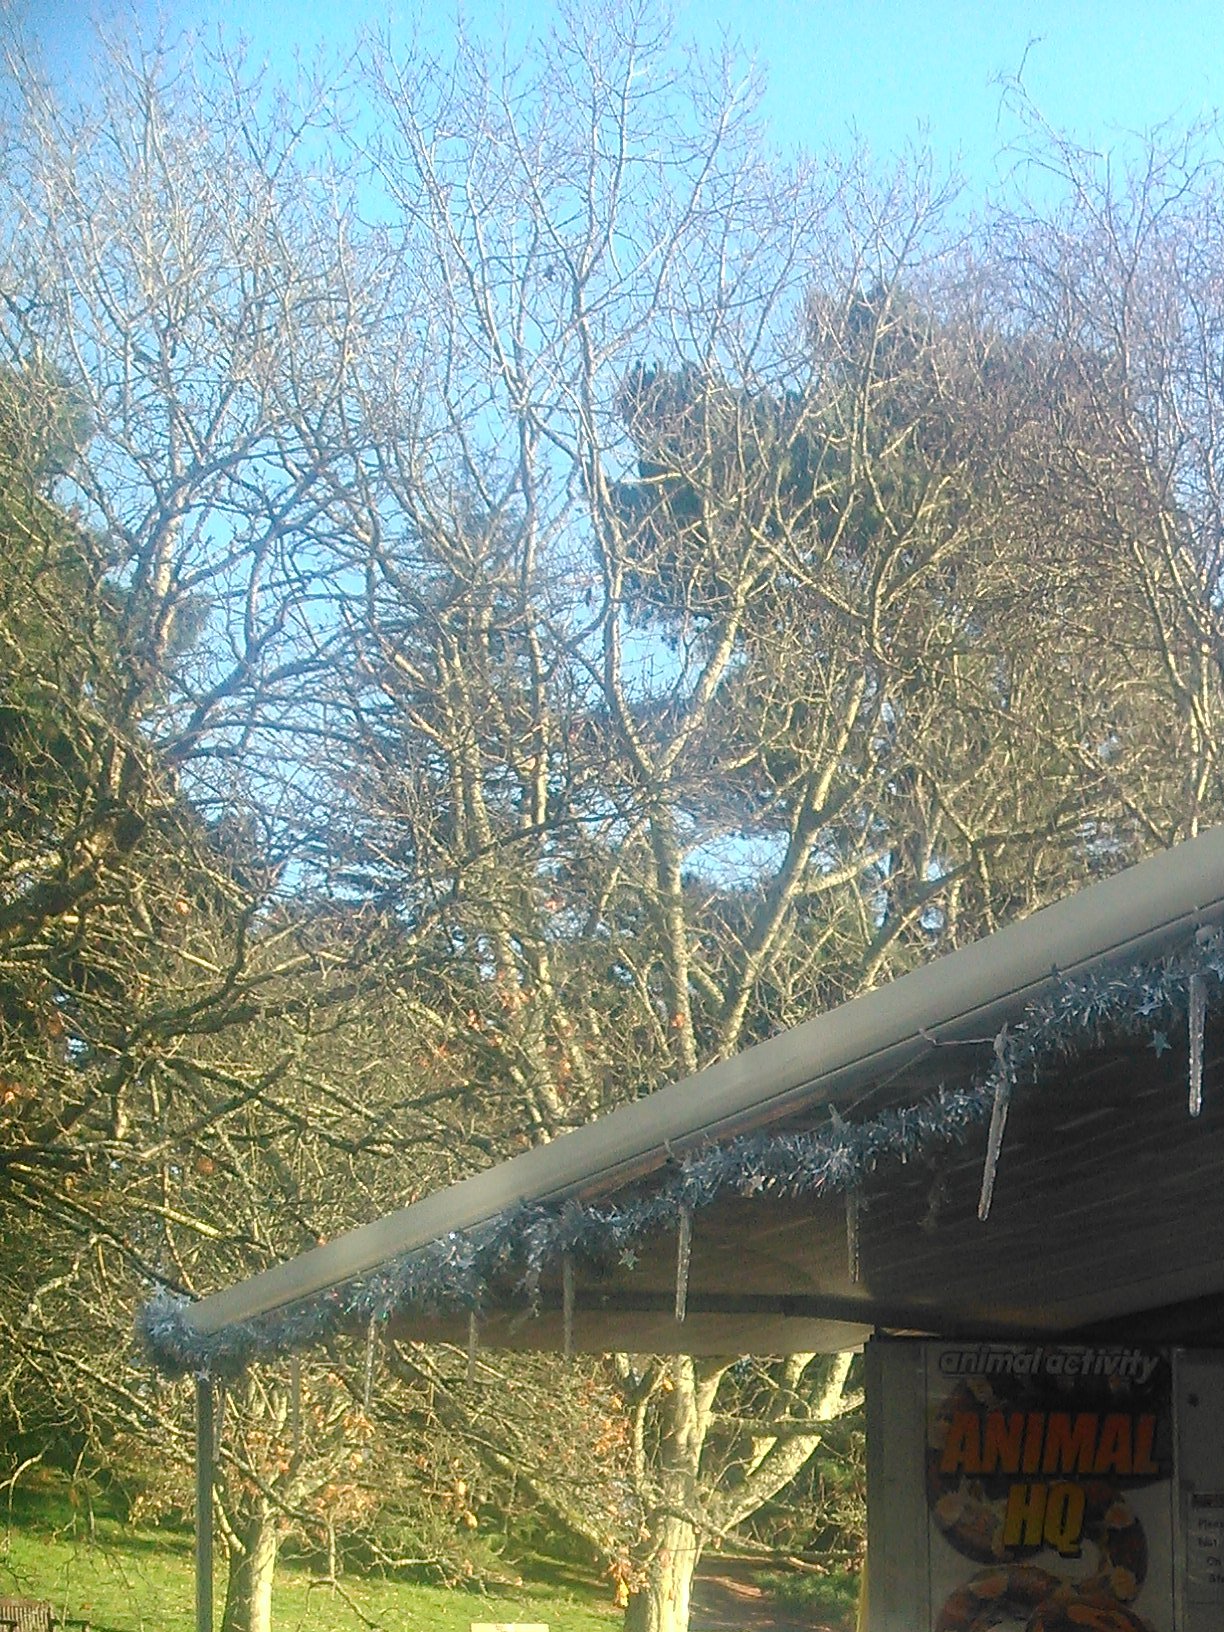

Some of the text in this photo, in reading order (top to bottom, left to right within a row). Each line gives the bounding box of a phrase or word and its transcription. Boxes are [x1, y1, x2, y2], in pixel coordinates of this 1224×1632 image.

[940, 1347, 1159, 1384] animal activity
[940, 1411, 1162, 1476] ANIMAL
[1004, 1484, 1086, 1557] HQ
